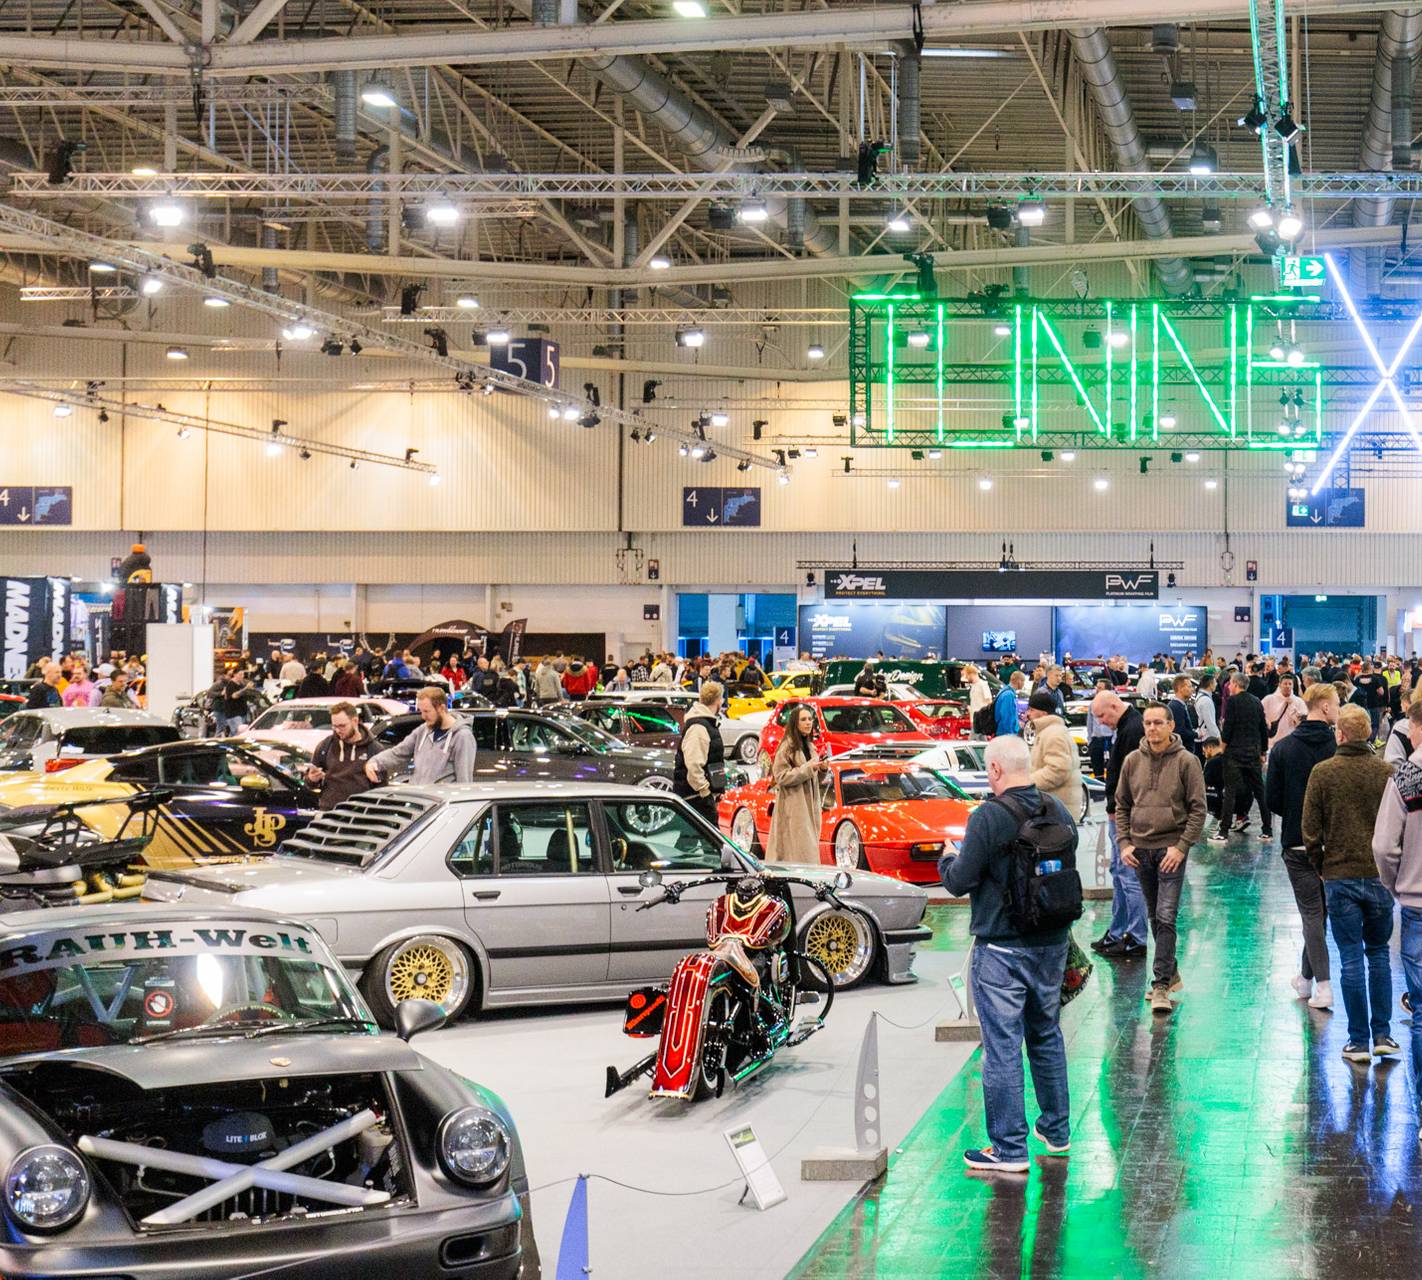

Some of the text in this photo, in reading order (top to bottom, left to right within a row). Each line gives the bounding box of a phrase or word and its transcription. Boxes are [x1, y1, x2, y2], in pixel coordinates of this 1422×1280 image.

[508, 343, 527, 380] 5
[545, 345, 556, 388] 5
[0, 488, 10, 507] 4
[686, 490, 698, 508] 4
[836, 574, 886, 590] XPEL
[1105, 575, 1154, 590] PWF
[1159, 614, 1198, 627] PWF
[780, 630, 789, 644] 4
[1276, 631, 1286, 645] 4
[0, 929, 313, 969] RAUH-Welt
